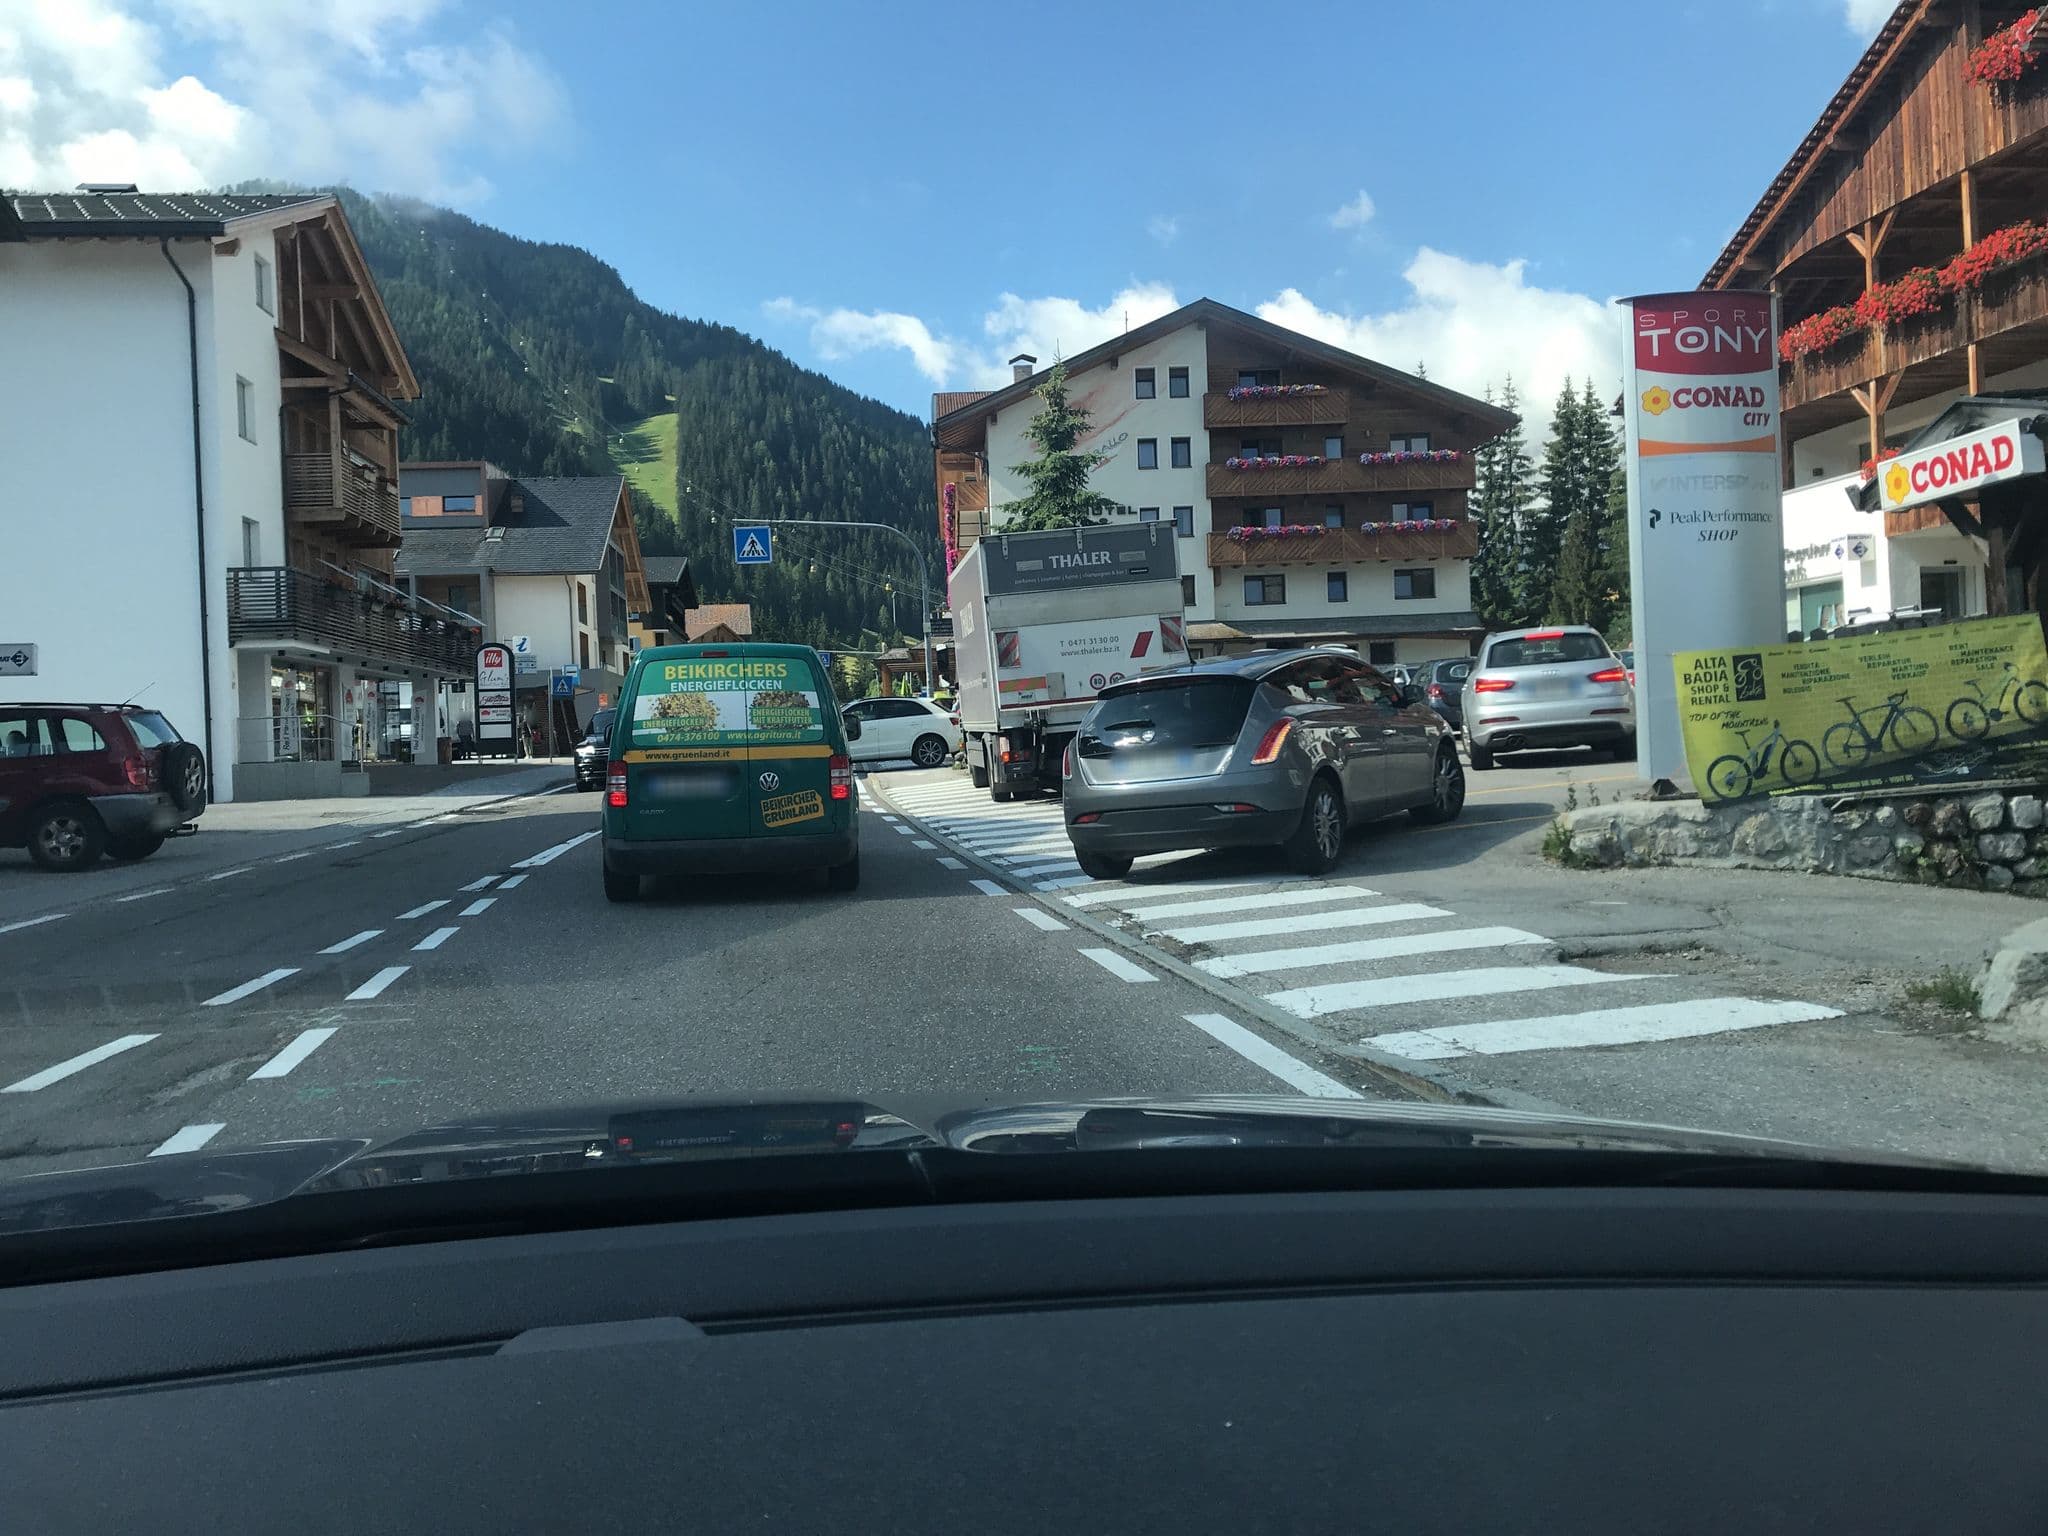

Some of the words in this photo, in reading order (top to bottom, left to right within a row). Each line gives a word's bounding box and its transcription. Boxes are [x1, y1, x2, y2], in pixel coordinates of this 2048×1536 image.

[1639, 309, 1768, 328] SPORT
[1639, 325, 1768, 357] TONY
[1672, 386, 1765, 409] CONAD
[1743, 412, 1770, 426] CITY
[1911, 435, 2014, 493] CONAD
[1698, 529, 1739, 542] SHOP
[1048, 551, 1112, 569] THALER
[1068, 639, 1086, 647] 0471
[1089, 637, 1097, 645] 31
[1109, 635, 1119, 643] 00
[1061, 646, 1120, 656] www.thaler.bz.it
[485, 652, 502, 666] illy
[1694, 656, 1727, 670] ALTA
[664, 663, 788, 680] BEIKIRCHERS
[1683, 669, 1729, 685] BADIA
[670, 680, 782, 693] ENERGIEFLOCKEN
[1690, 684, 1720, 695] SHOP
[1690, 694, 1731, 706] RENTAL
[753, 708, 810, 716] ENERGIEFLOCKEN
[1689, 713, 1709, 721] TOP
[642, 718, 706, 729] ENERGIEFLOCKEN
[753, 716, 767, 724] MIT
[768, 716, 813, 724] KRAFTFUTTER
[656, 731, 720, 743] 0474-376100
[727, 731, 802, 741] www.agritura.it
[645, 751, 730, 760] www.gruenland.it
[762, 790, 817, 812] BEIKIRCHER
